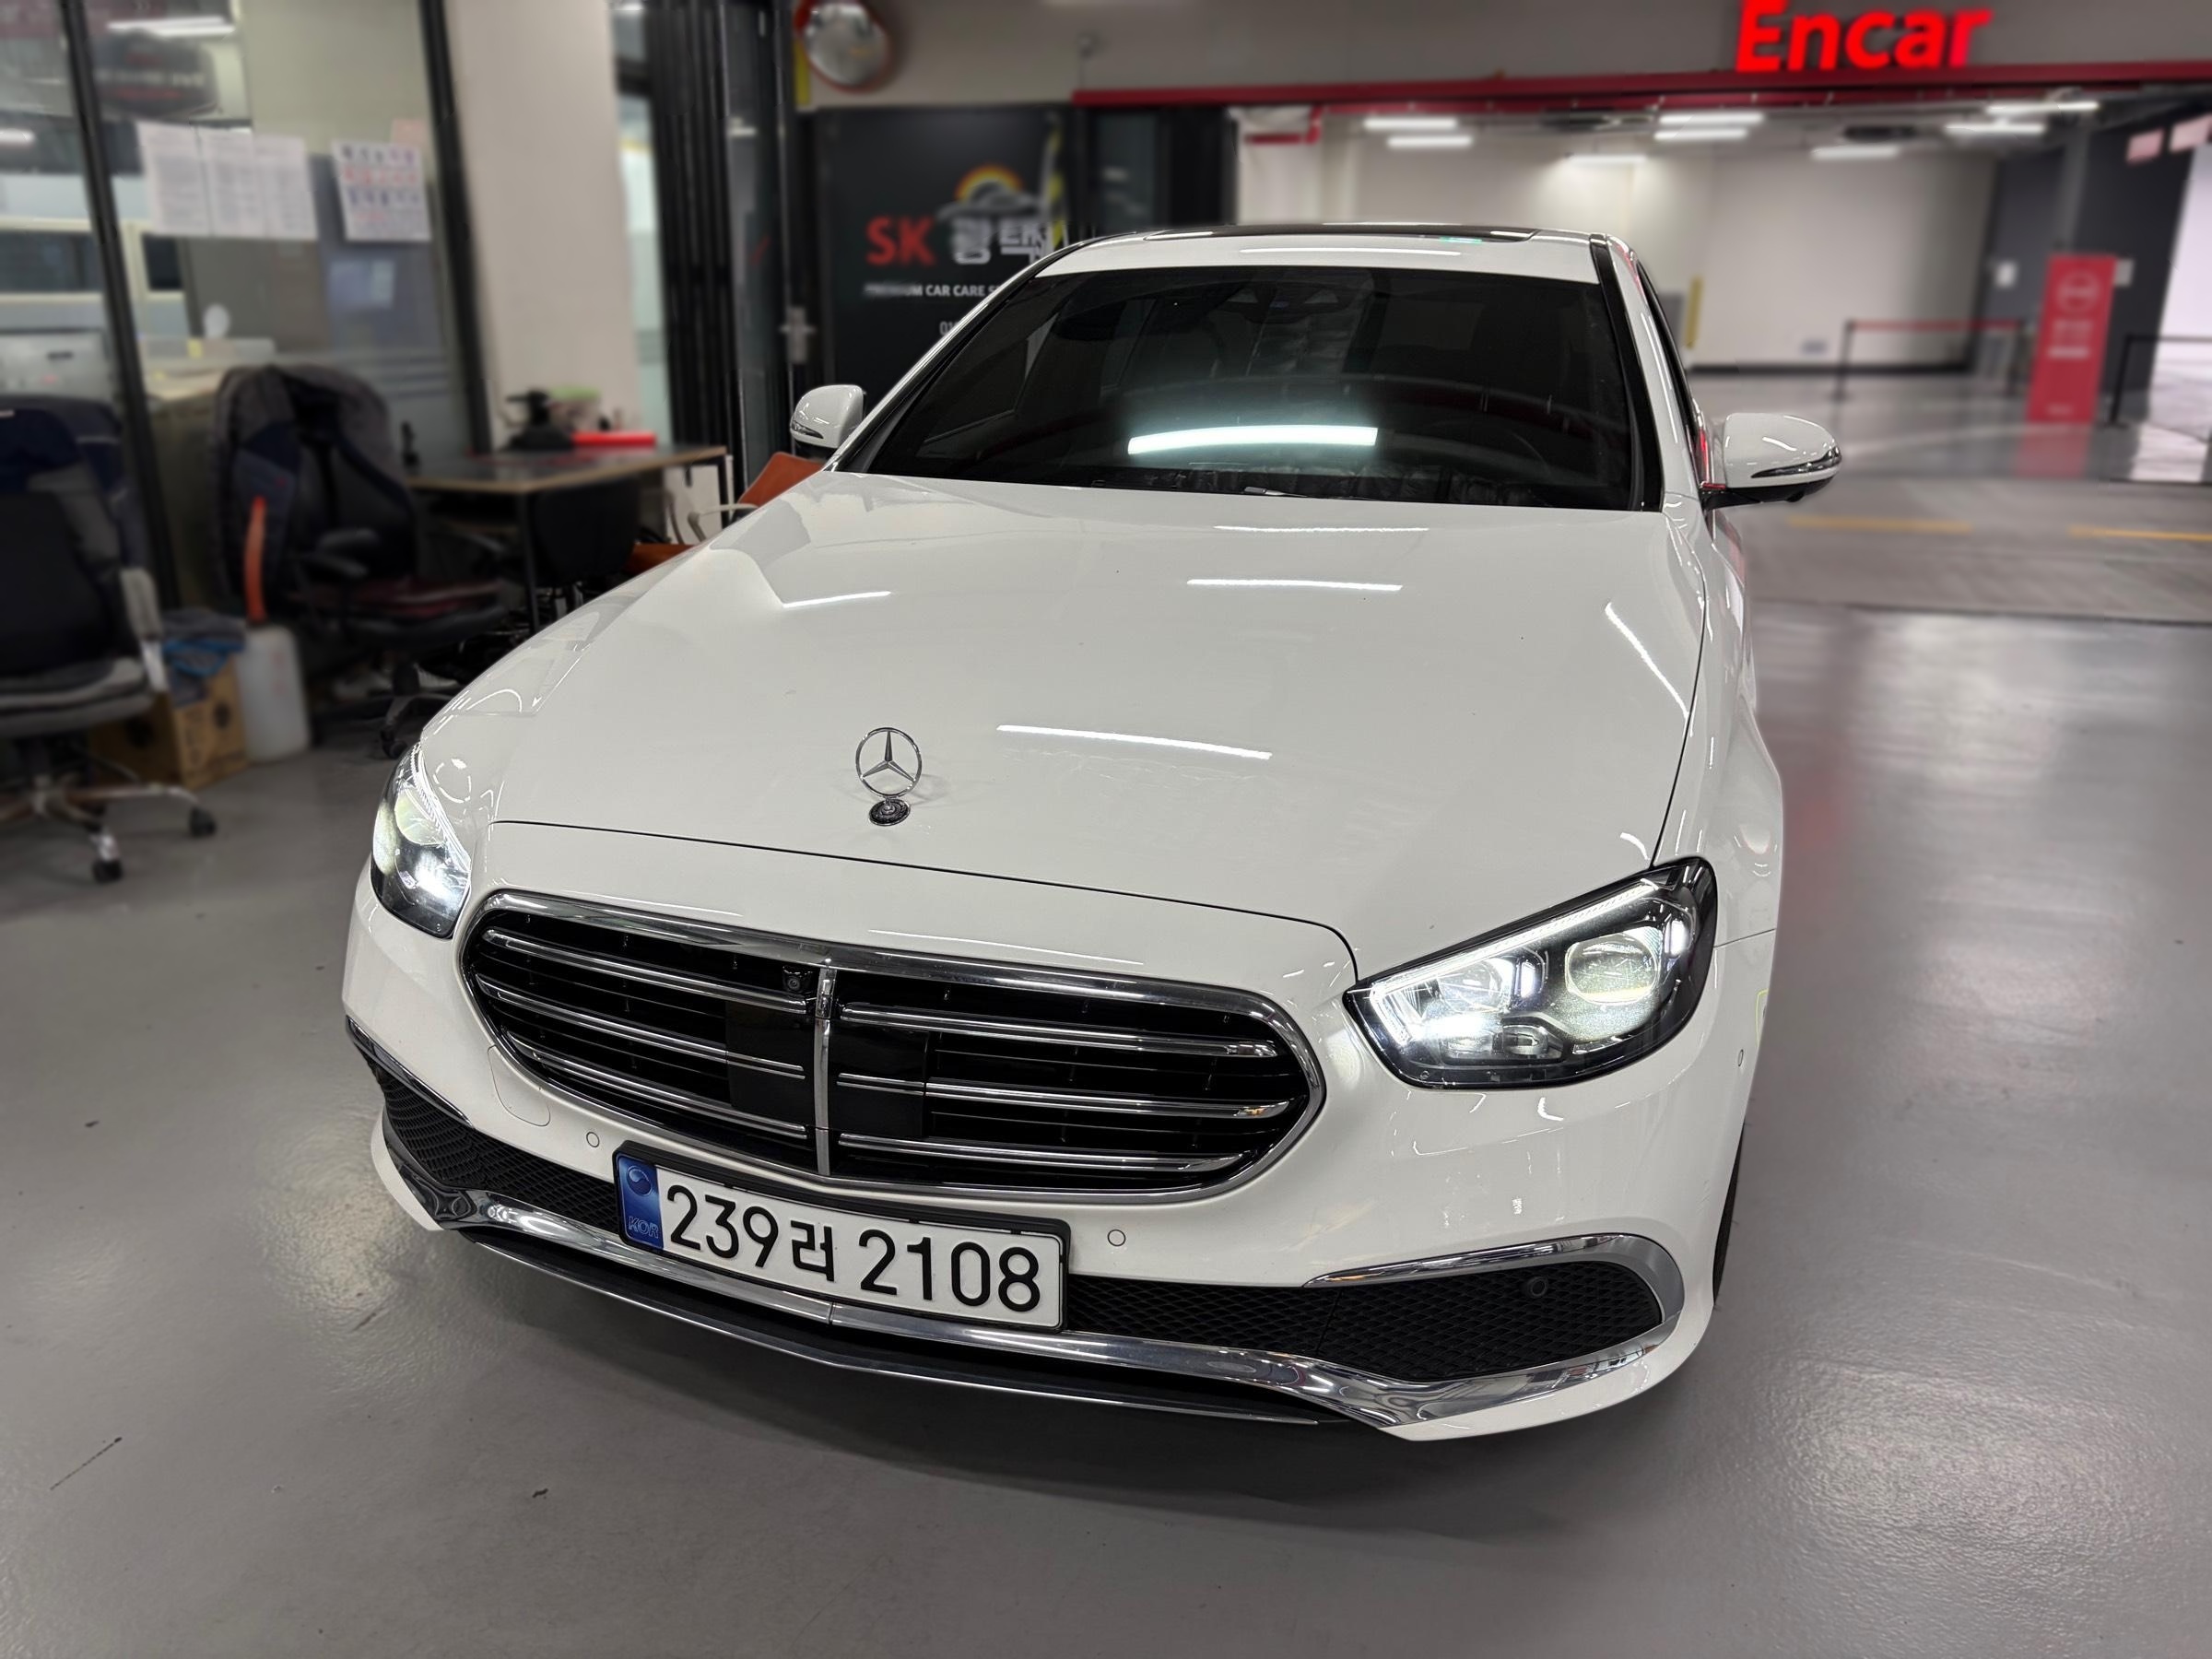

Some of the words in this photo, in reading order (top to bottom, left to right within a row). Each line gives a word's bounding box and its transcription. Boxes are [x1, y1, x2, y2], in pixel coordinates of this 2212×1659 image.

[1735, 0, 1993, 72] Encar
[866, 216, 936, 265] SK
[925, 285, 950, 297] CAR
[953, 285, 985, 297] CARE
[628, 1216, 659, 1240] KOR
[666, 1184, 834, 1282] 239러
[859, 1229, 1041, 1312] 2108
